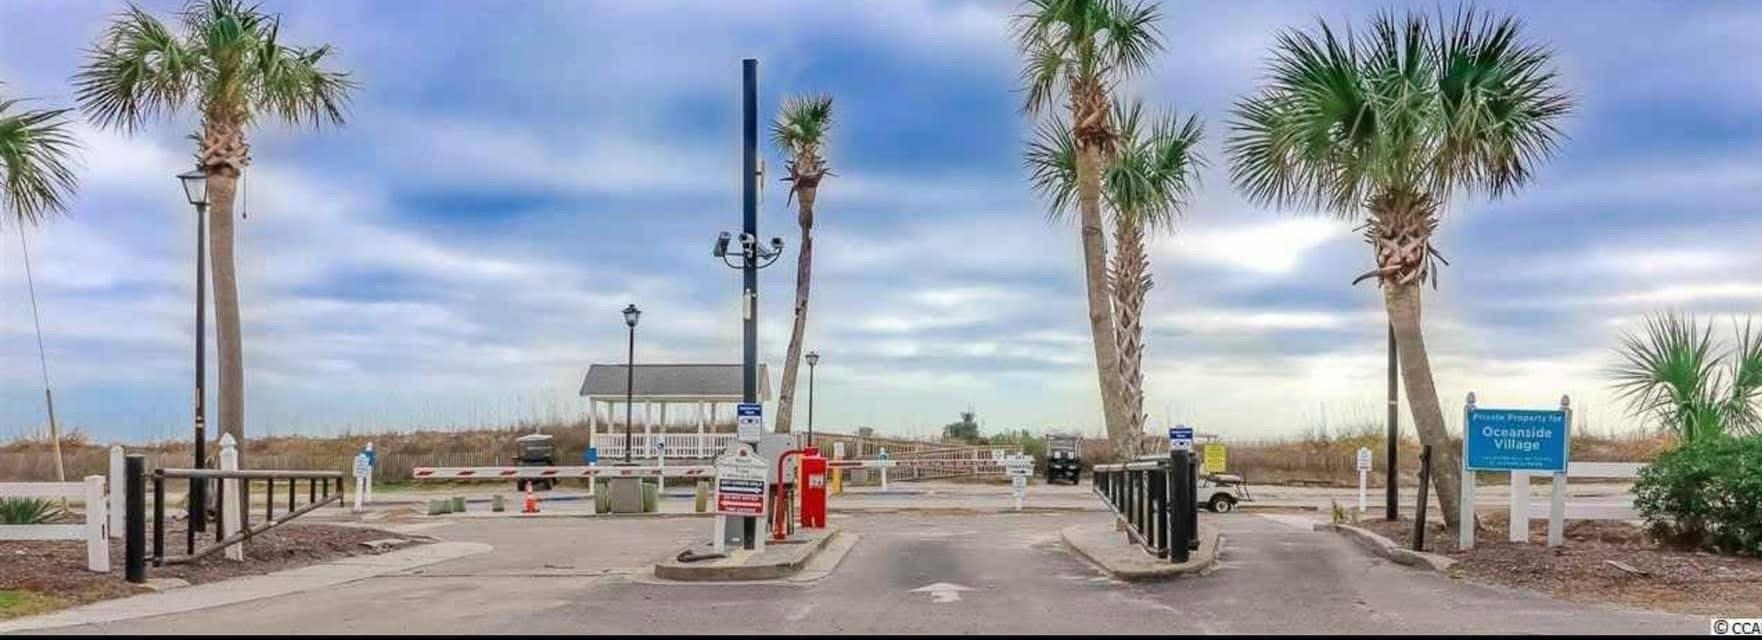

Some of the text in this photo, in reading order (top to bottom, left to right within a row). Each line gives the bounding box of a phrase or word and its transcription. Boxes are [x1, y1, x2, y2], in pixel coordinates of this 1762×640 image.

[1473, 413, 1504, 421] Private
[1507, 413, 1546, 423] Property
[1482, 426, 1553, 438] Oceanside
[1494, 439, 1541, 452] Village
